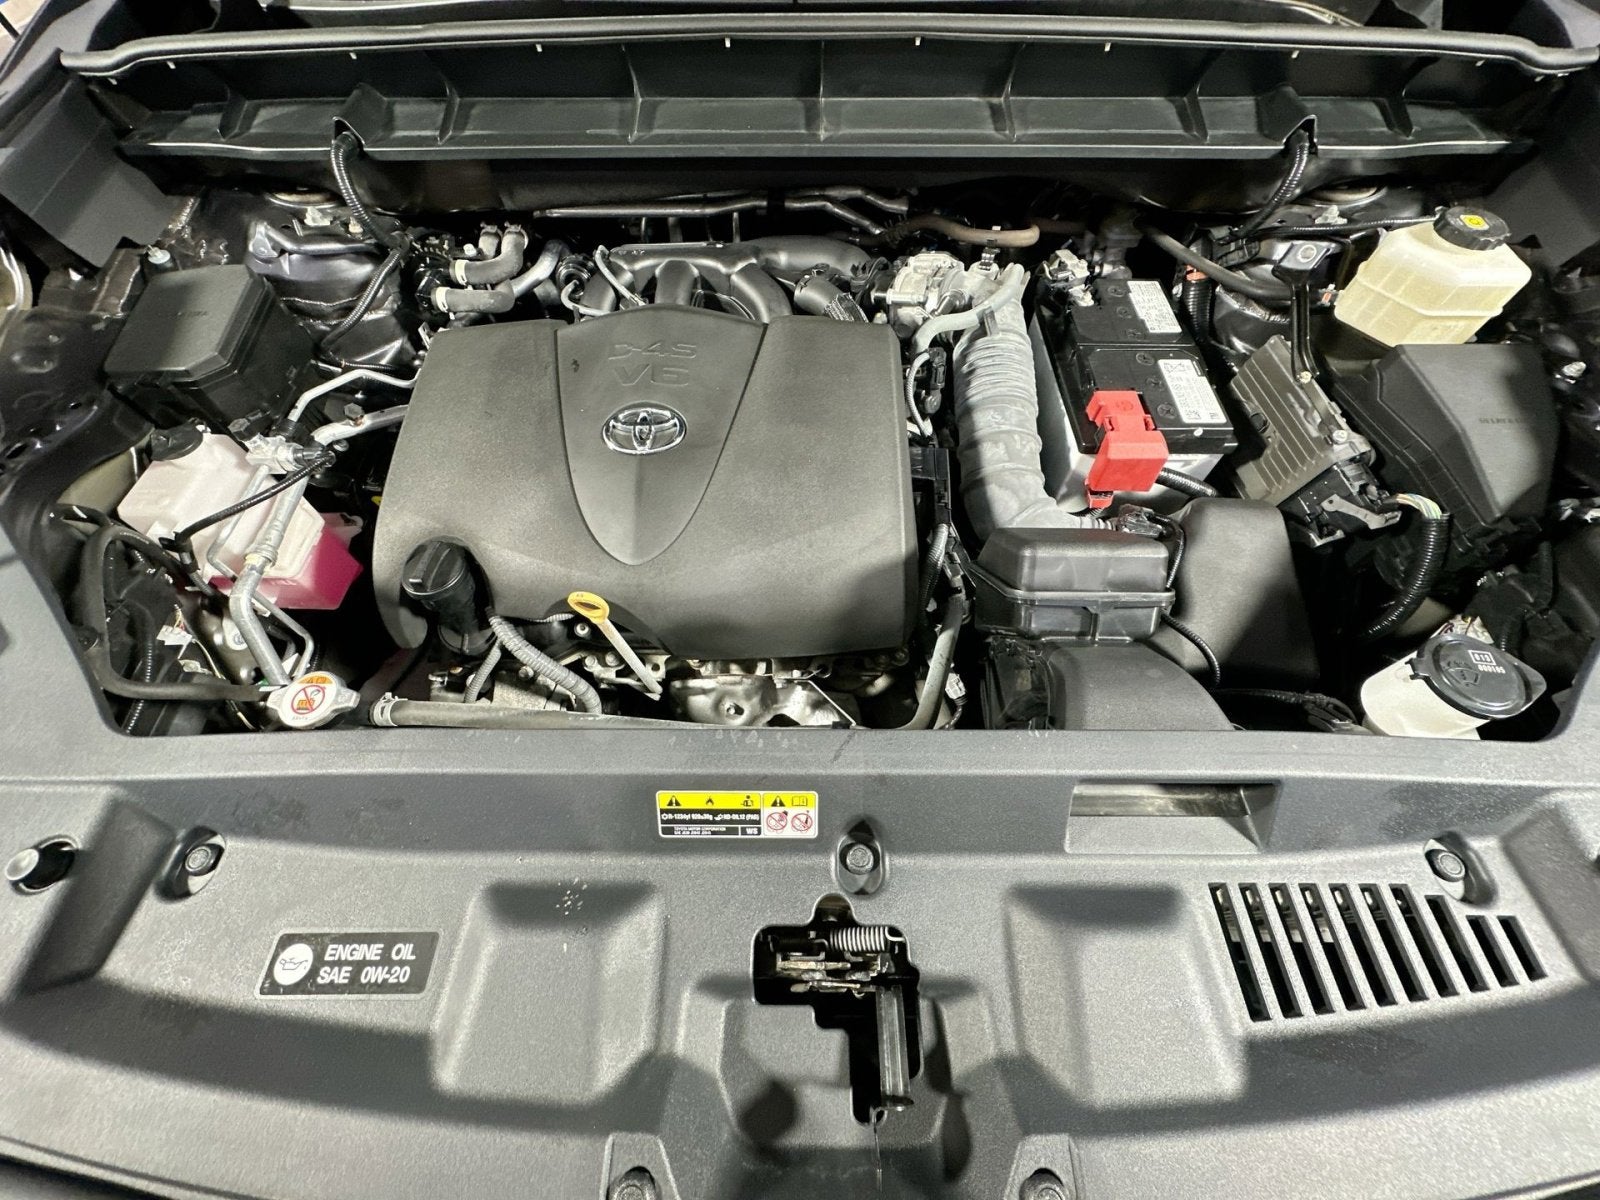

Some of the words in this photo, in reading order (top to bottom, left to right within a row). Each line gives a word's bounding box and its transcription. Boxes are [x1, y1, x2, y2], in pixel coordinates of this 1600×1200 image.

[614, 364, 689, 387] V6
[324, 943, 384, 961] ENGINE
[391, 943, 416, 960] OIL
[316, 966, 352, 984] SAE
[360, 966, 411, 984] 0W-20
